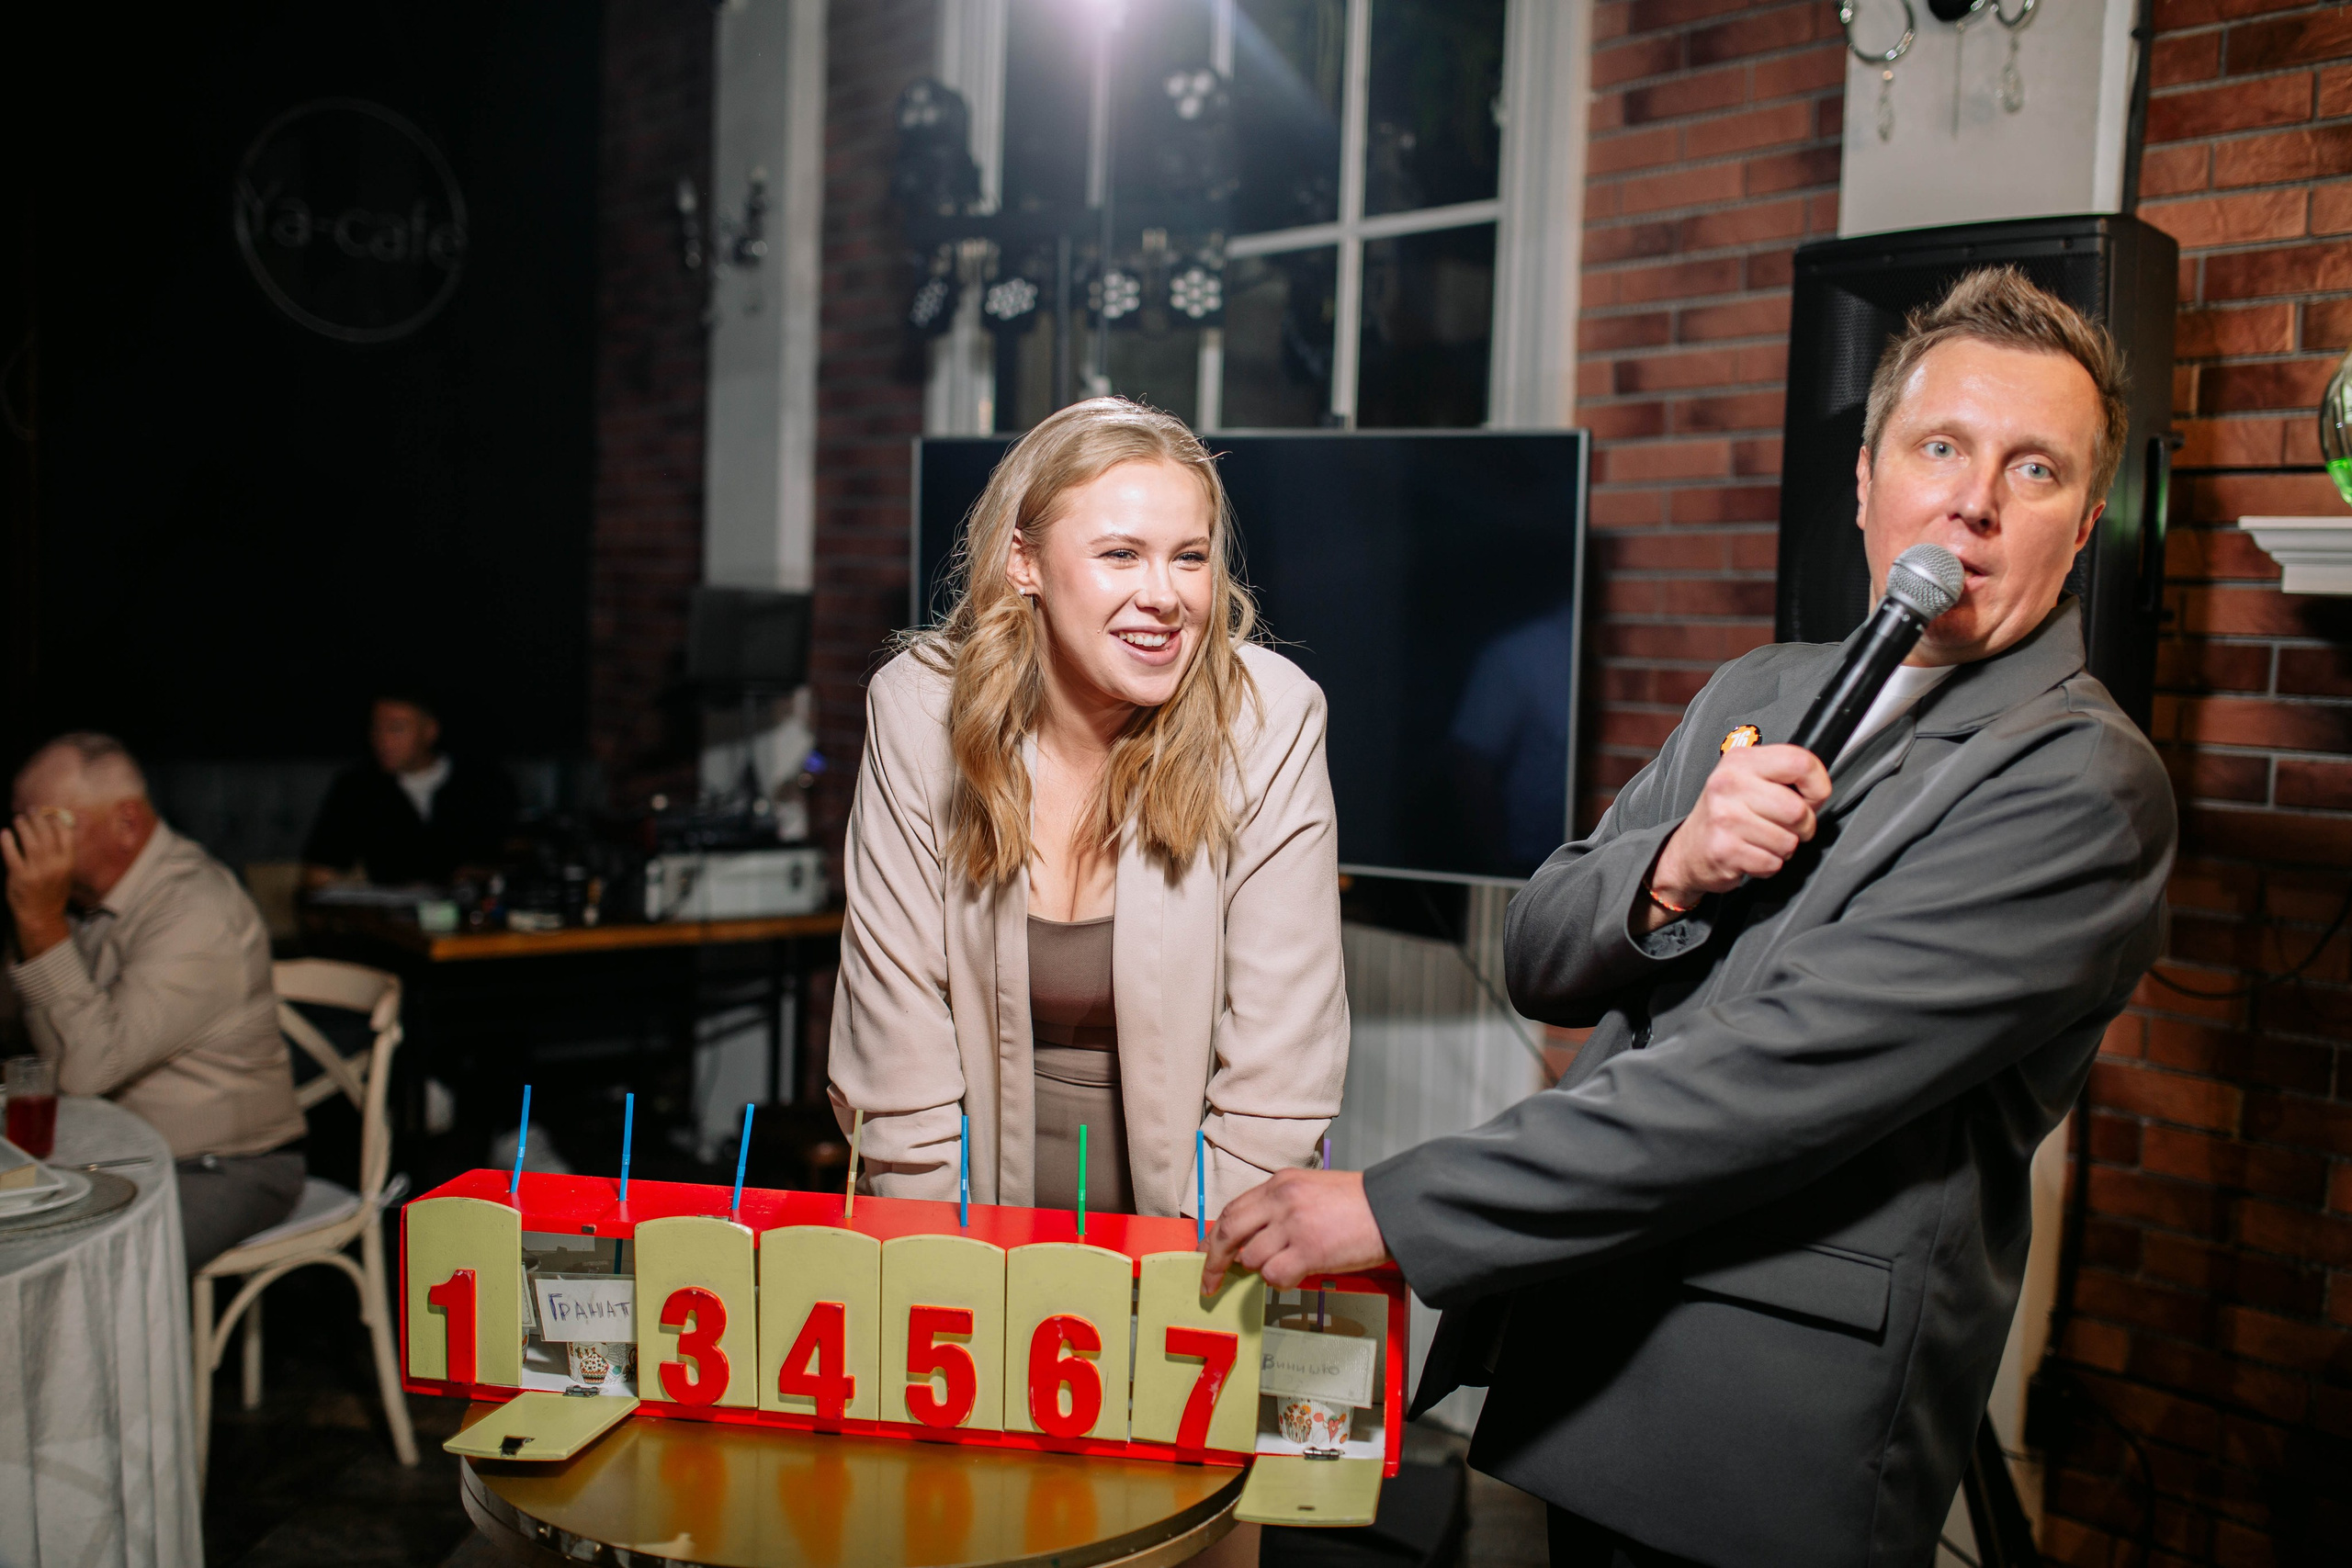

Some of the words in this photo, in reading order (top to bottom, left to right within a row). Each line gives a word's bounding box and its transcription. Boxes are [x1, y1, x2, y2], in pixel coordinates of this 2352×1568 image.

[430, 1269, 476, 1385] 1
[659, 1287, 730, 1407] 3
[779, 1302, 855, 1421] 4
[905, 1304, 976, 1427] 5
[1029, 1314, 1102, 1438] 6
[1165, 1326, 1238, 1450] 7
